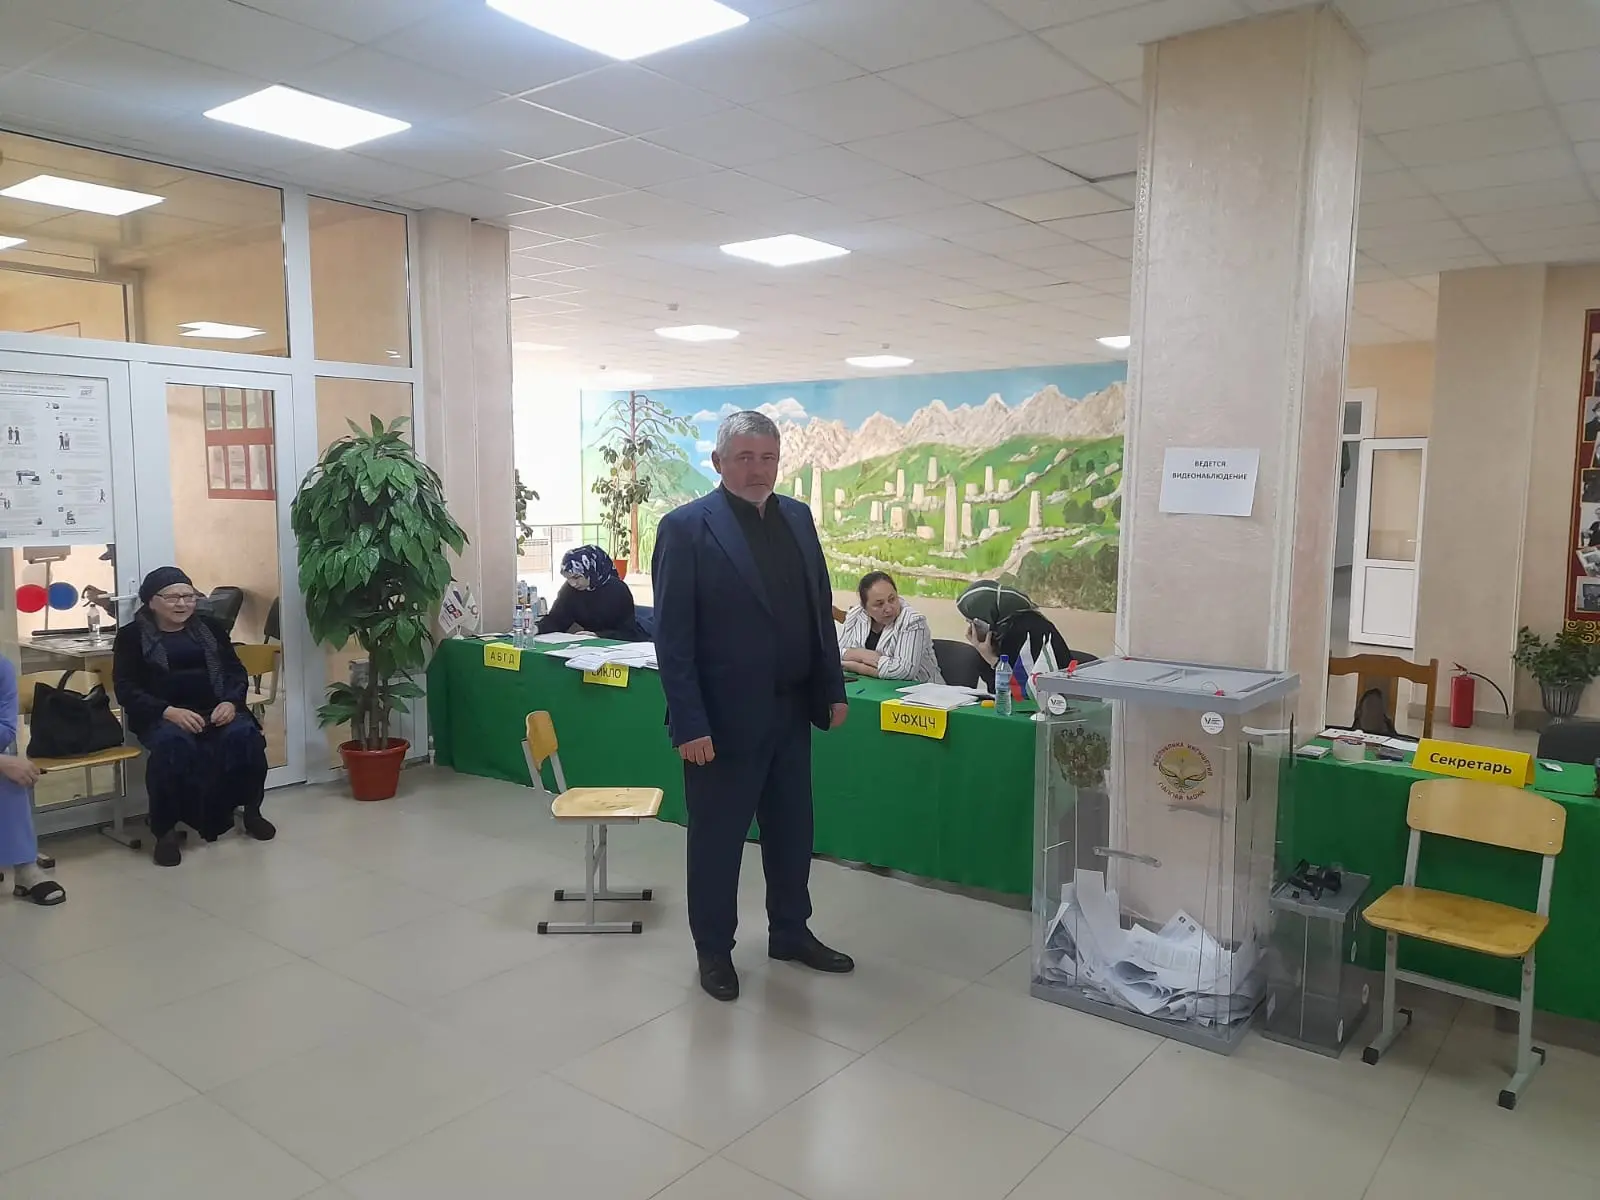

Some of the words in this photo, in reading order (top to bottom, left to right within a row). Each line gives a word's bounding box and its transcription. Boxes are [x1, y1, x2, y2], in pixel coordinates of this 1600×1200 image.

[1194, 460, 1226, 468] ВЕДЕТСЯ
[1172, 472, 1248, 480] ВИДЕОНАБЛЮДЕНИЕ
[891, 711, 936, 730] УФХЦЧ
[1430, 752, 1512, 775] Секретарь
